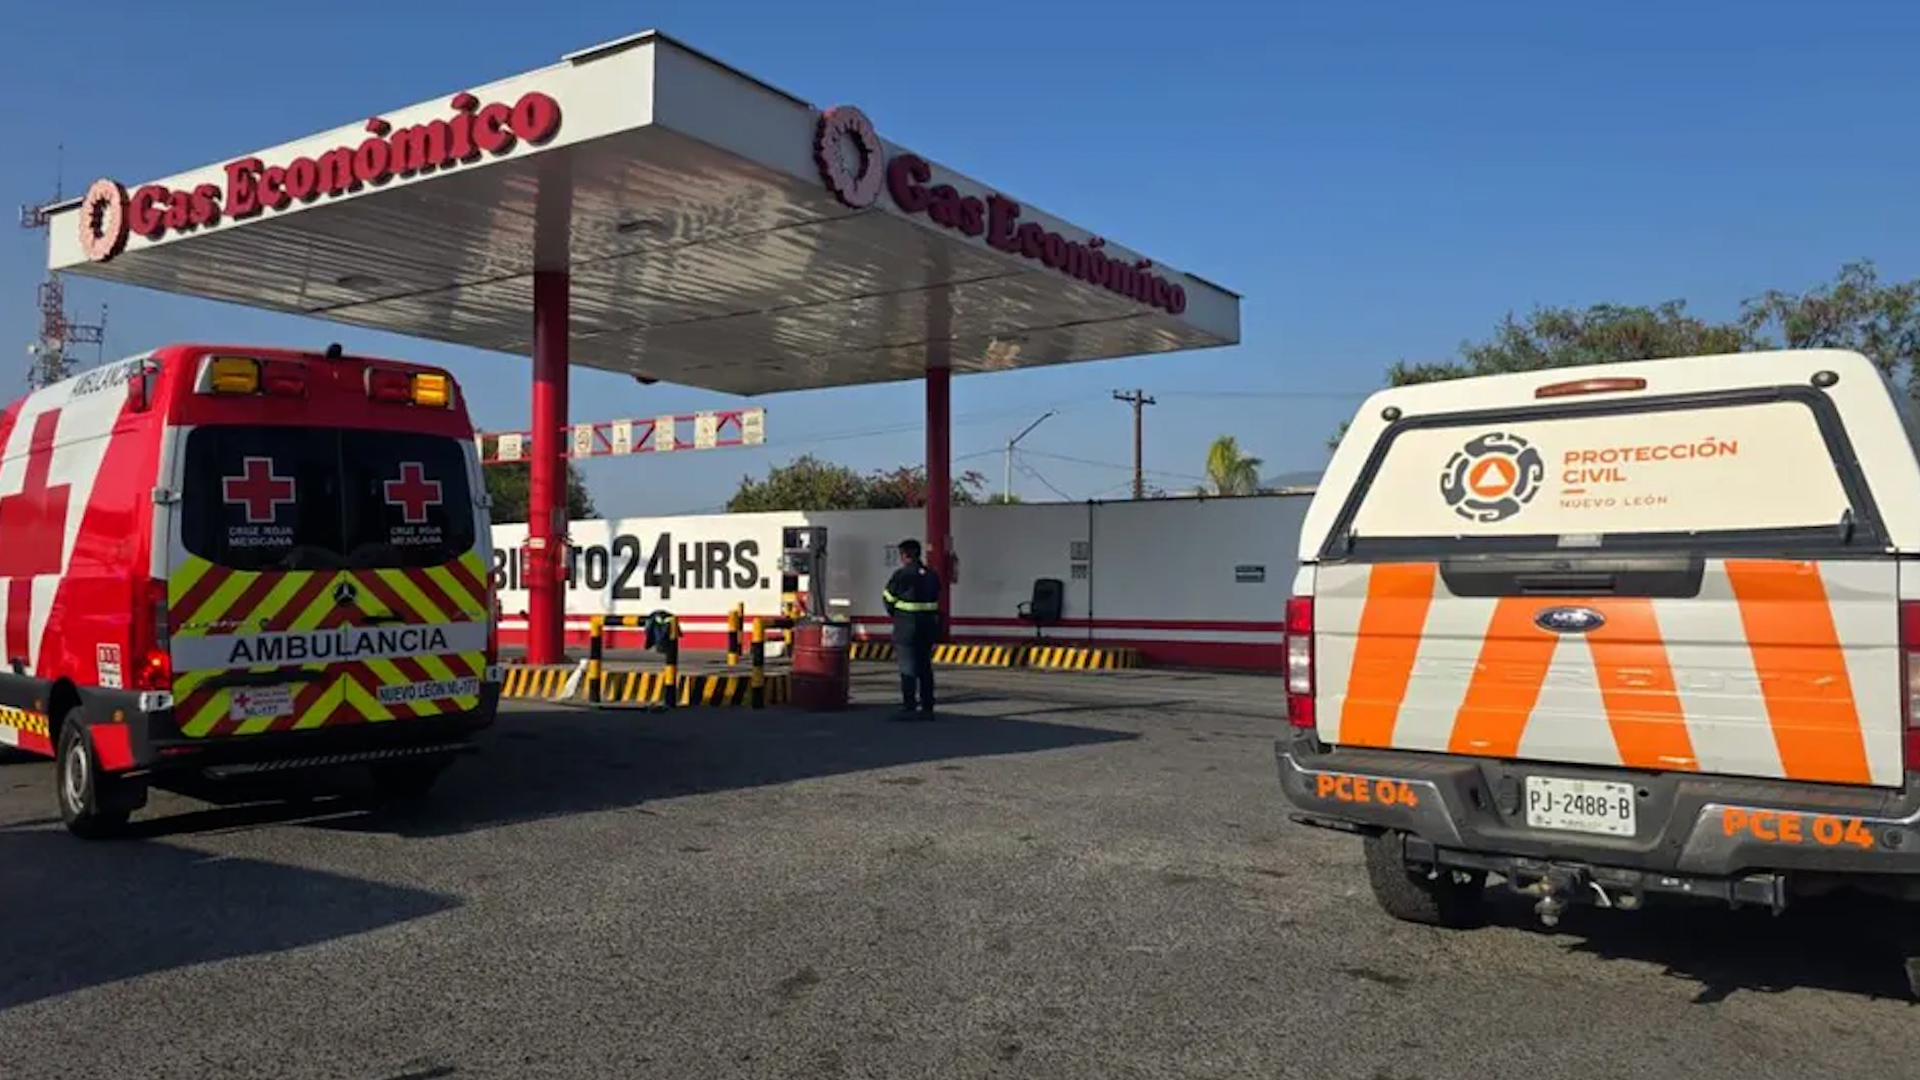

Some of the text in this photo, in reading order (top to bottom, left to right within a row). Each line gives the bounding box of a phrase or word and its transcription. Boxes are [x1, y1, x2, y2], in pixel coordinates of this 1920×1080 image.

[129, 92, 561, 239] Gas Económico
[887, 153, 1187, 314] Gas Económico
[1564, 437, 1738, 465] PROTECCIÓN
[1563, 468, 1627, 484] CIVIL
[1560, 494, 1668, 509] NUEVO LEÓN
[229, 526, 259, 536] CRUZ
[229, 537, 293, 547] MEXICANA
[228, 627, 448, 663] AMBULANCIA
[381, 686, 416, 701] NUEVO
[1315, 773, 1418, 808] PCE 04
[1530, 790, 1630, 820] PJ-2488-B
[1722, 806, 1875, 849] PCE 04
